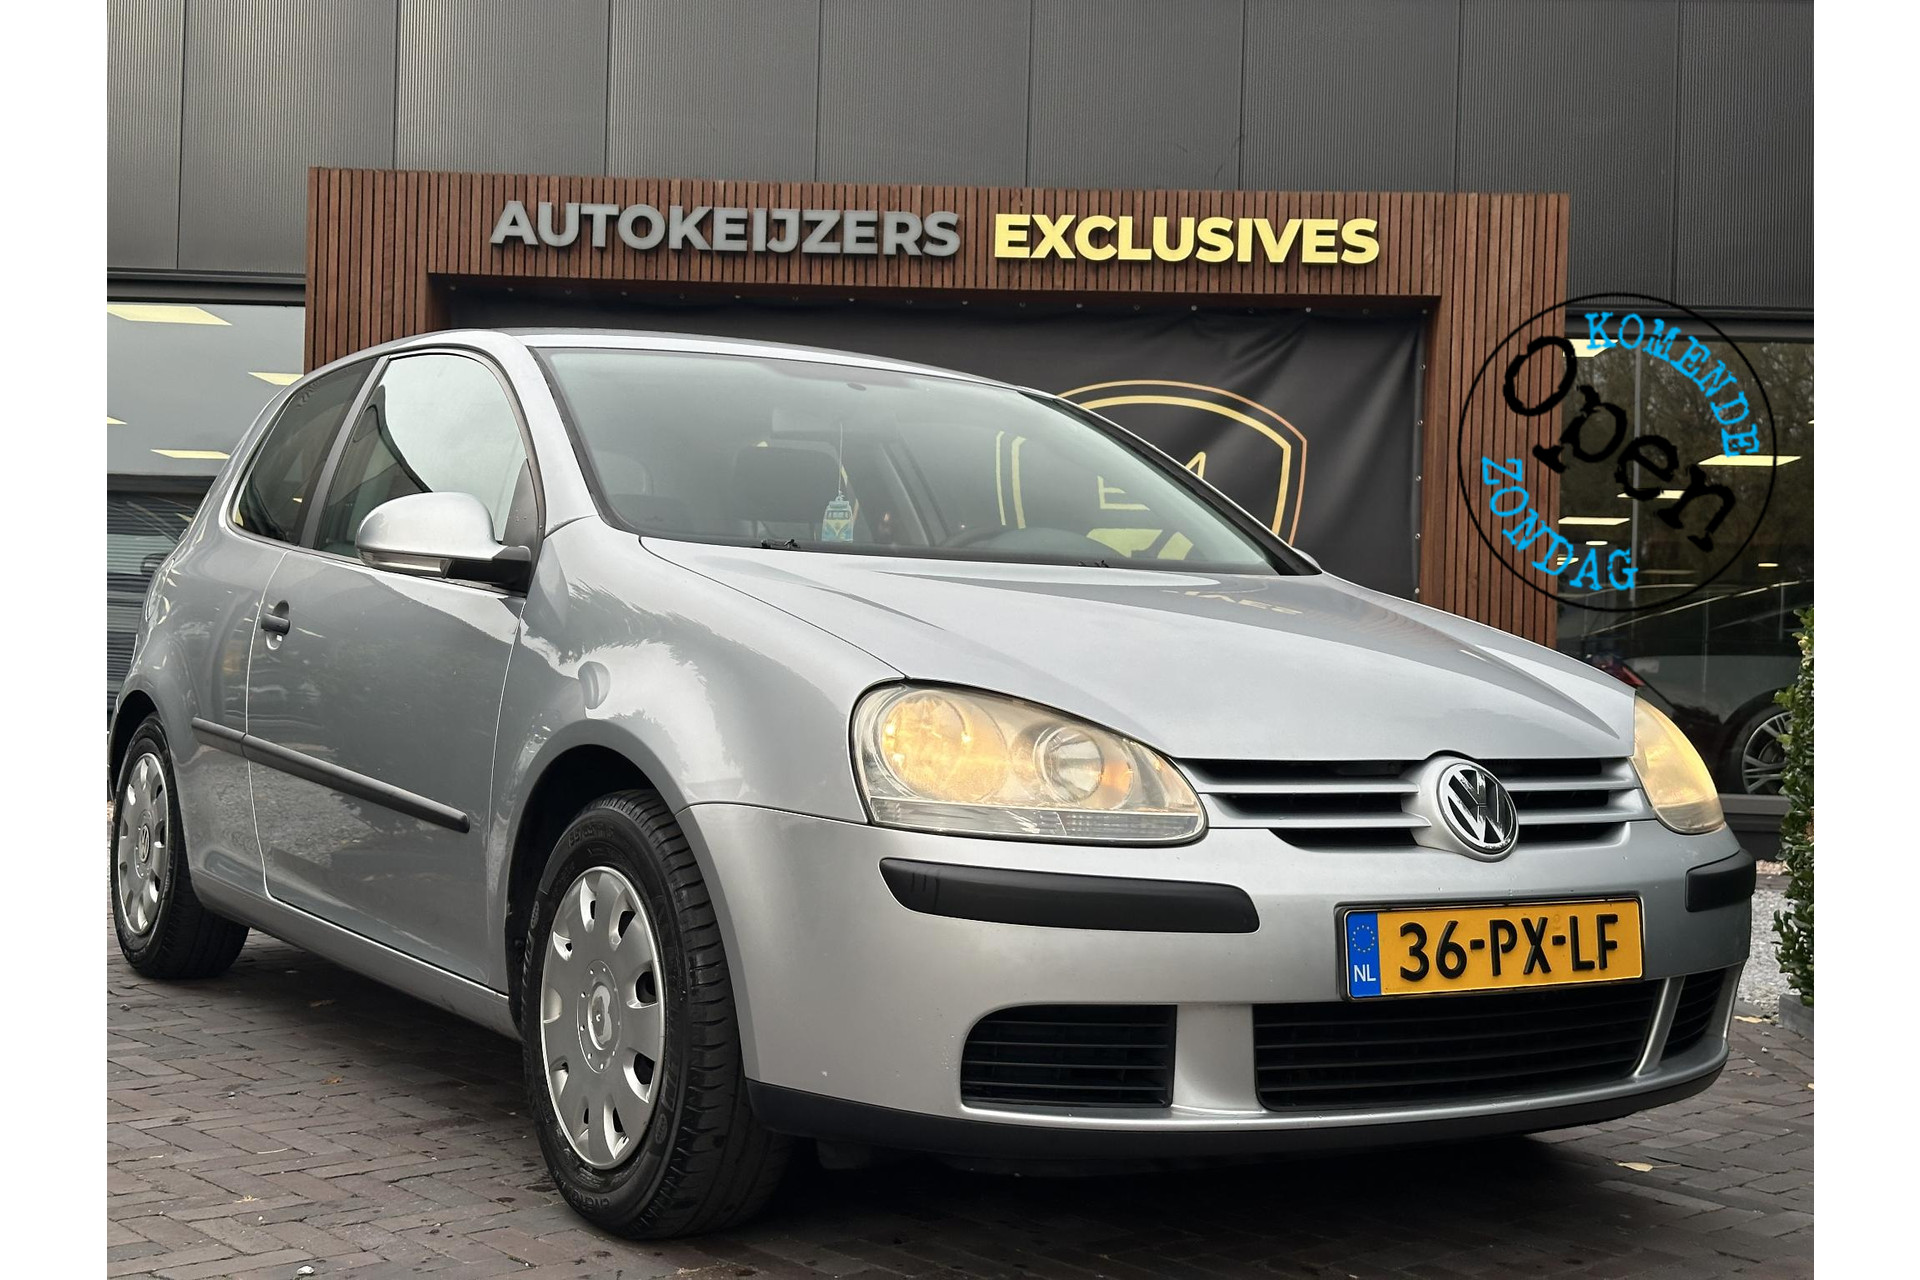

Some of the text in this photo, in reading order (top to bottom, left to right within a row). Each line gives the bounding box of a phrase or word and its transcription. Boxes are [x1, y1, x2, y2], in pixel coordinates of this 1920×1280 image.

[490, 200, 1380, 264] AUTOKEIJZERS EXCLUSIVES
[1354, 964, 1376, 982] NL
[1400, 913, 1618, 982] 36-PX-LF
